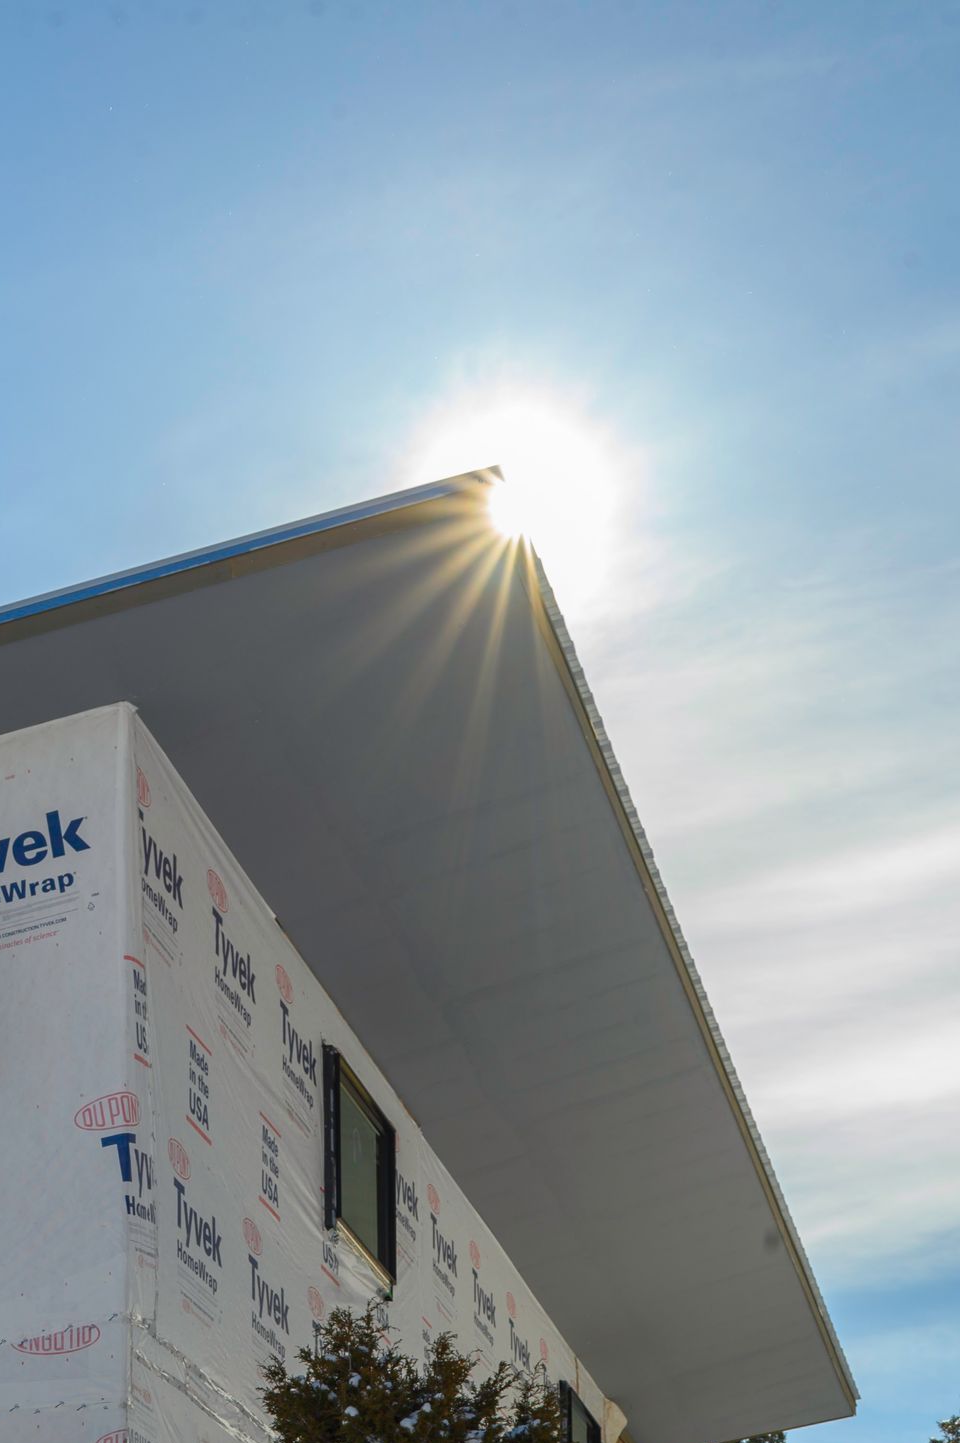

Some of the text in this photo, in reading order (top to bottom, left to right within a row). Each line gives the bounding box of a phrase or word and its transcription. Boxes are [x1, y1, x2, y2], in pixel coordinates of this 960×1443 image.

[138, 808, 183, 910] yvek
[142, 877, 178, 934] omeWrap
[212, 906, 256, 1004] Tyvek
[214, 966, 252, 1027] HomeWrap
[280, 999, 317, 1086] Tyvek
[190, 1088, 209, 1130] USA
[174, 1177, 222, 1268] Tyvek
[176, 1239, 218, 1295] HomeWrap
[248, 1254, 290, 1335] Tyvek
